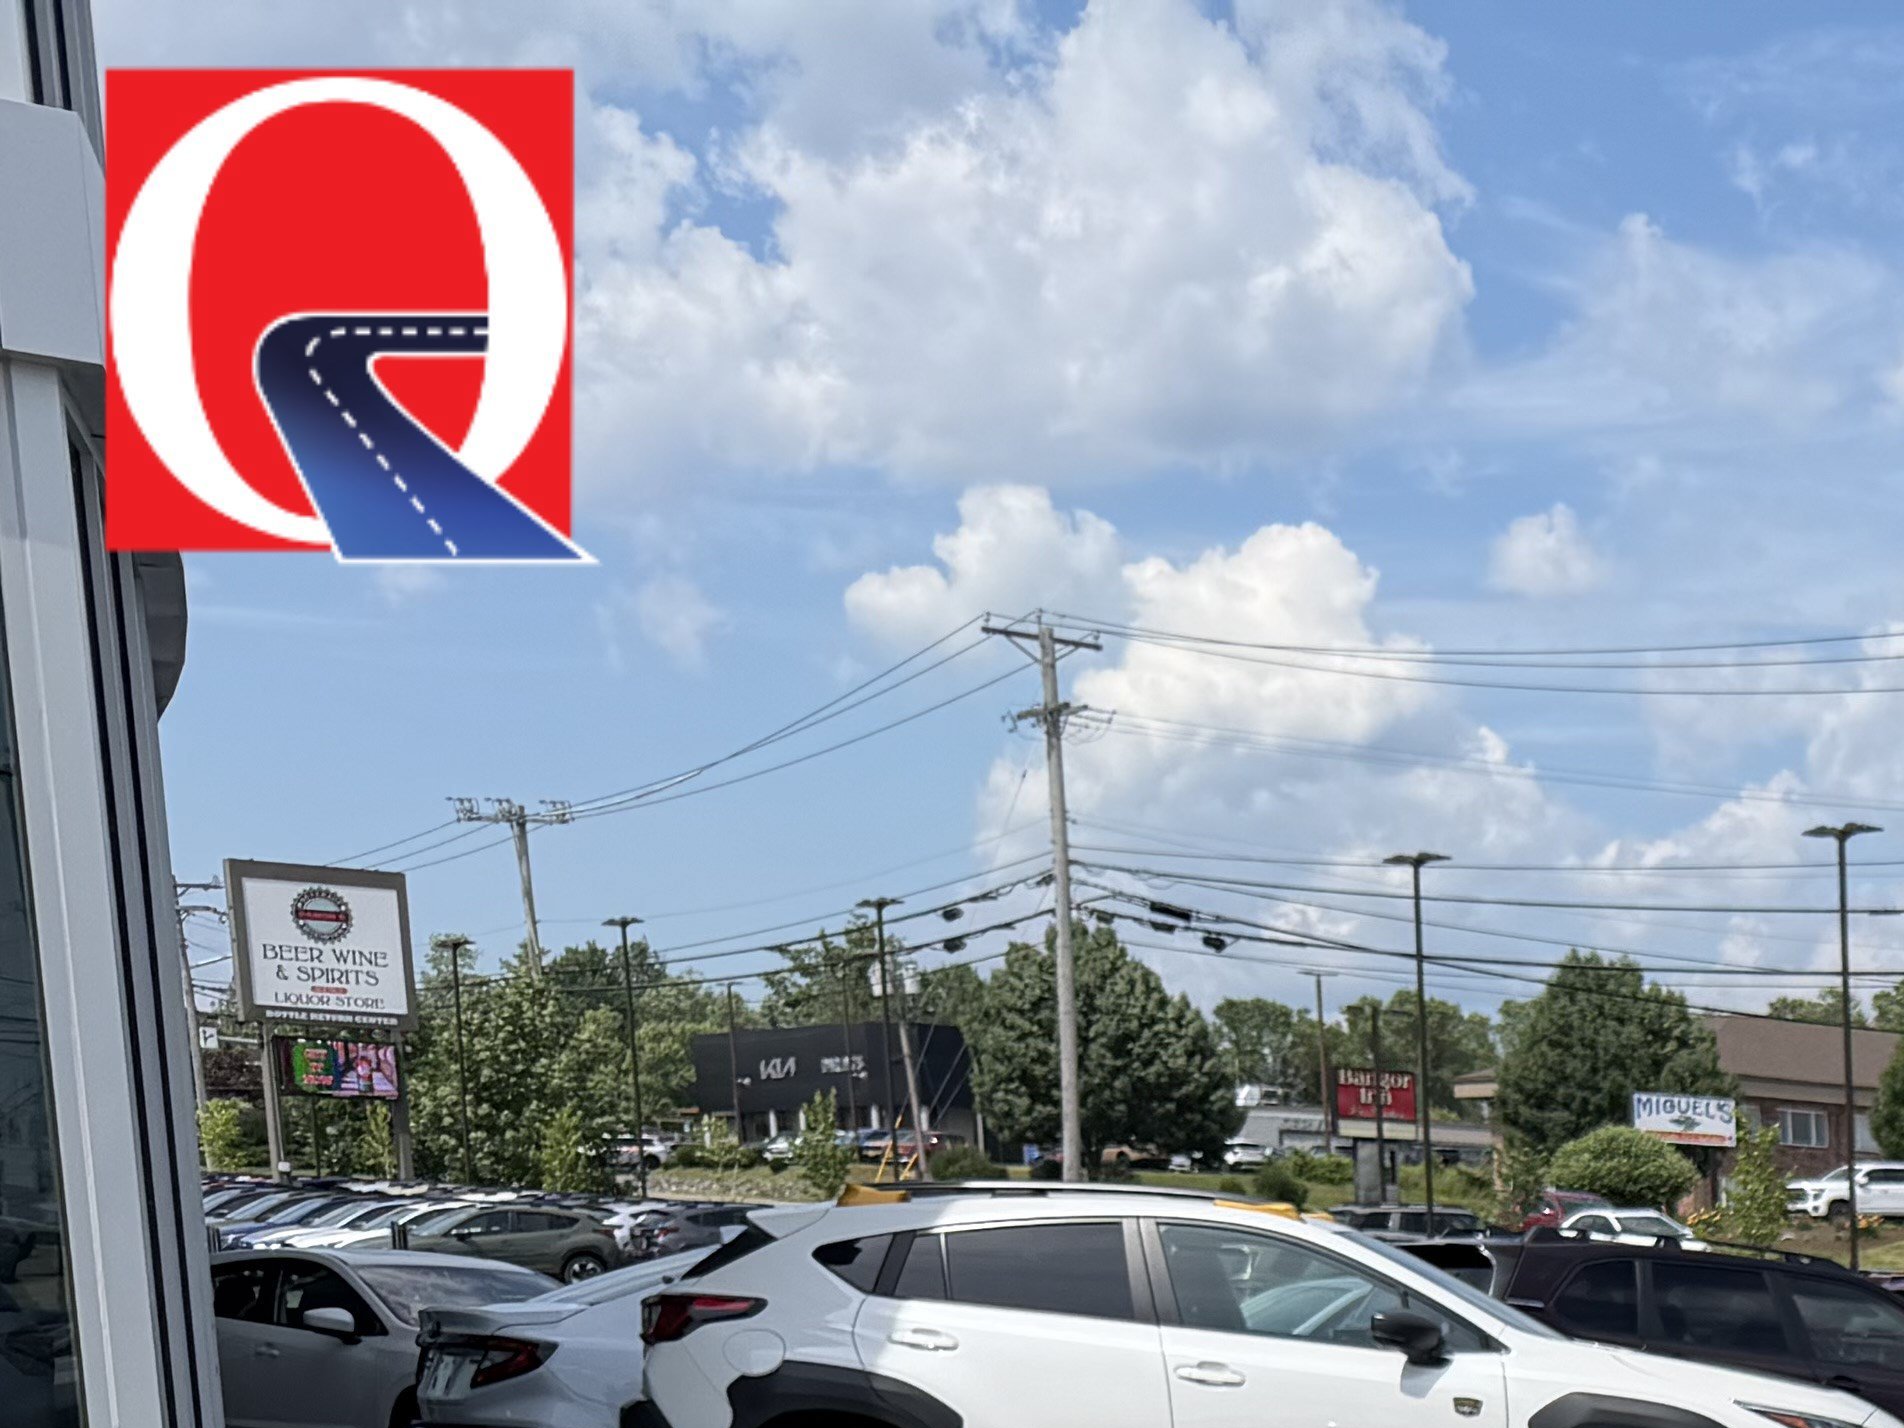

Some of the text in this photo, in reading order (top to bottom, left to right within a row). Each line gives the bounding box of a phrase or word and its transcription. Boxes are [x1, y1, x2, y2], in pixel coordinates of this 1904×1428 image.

[262, 943, 389, 968] BEER WINE
[276, 964, 379, 986] & SPIRITS
[275, 992, 386, 1010] LIQUOR STORE
[265, 1010, 309, 1021] BOTTLE
[760, 1056, 797, 1080] KIA
[1338, 1069, 1412, 1090] Bangor
